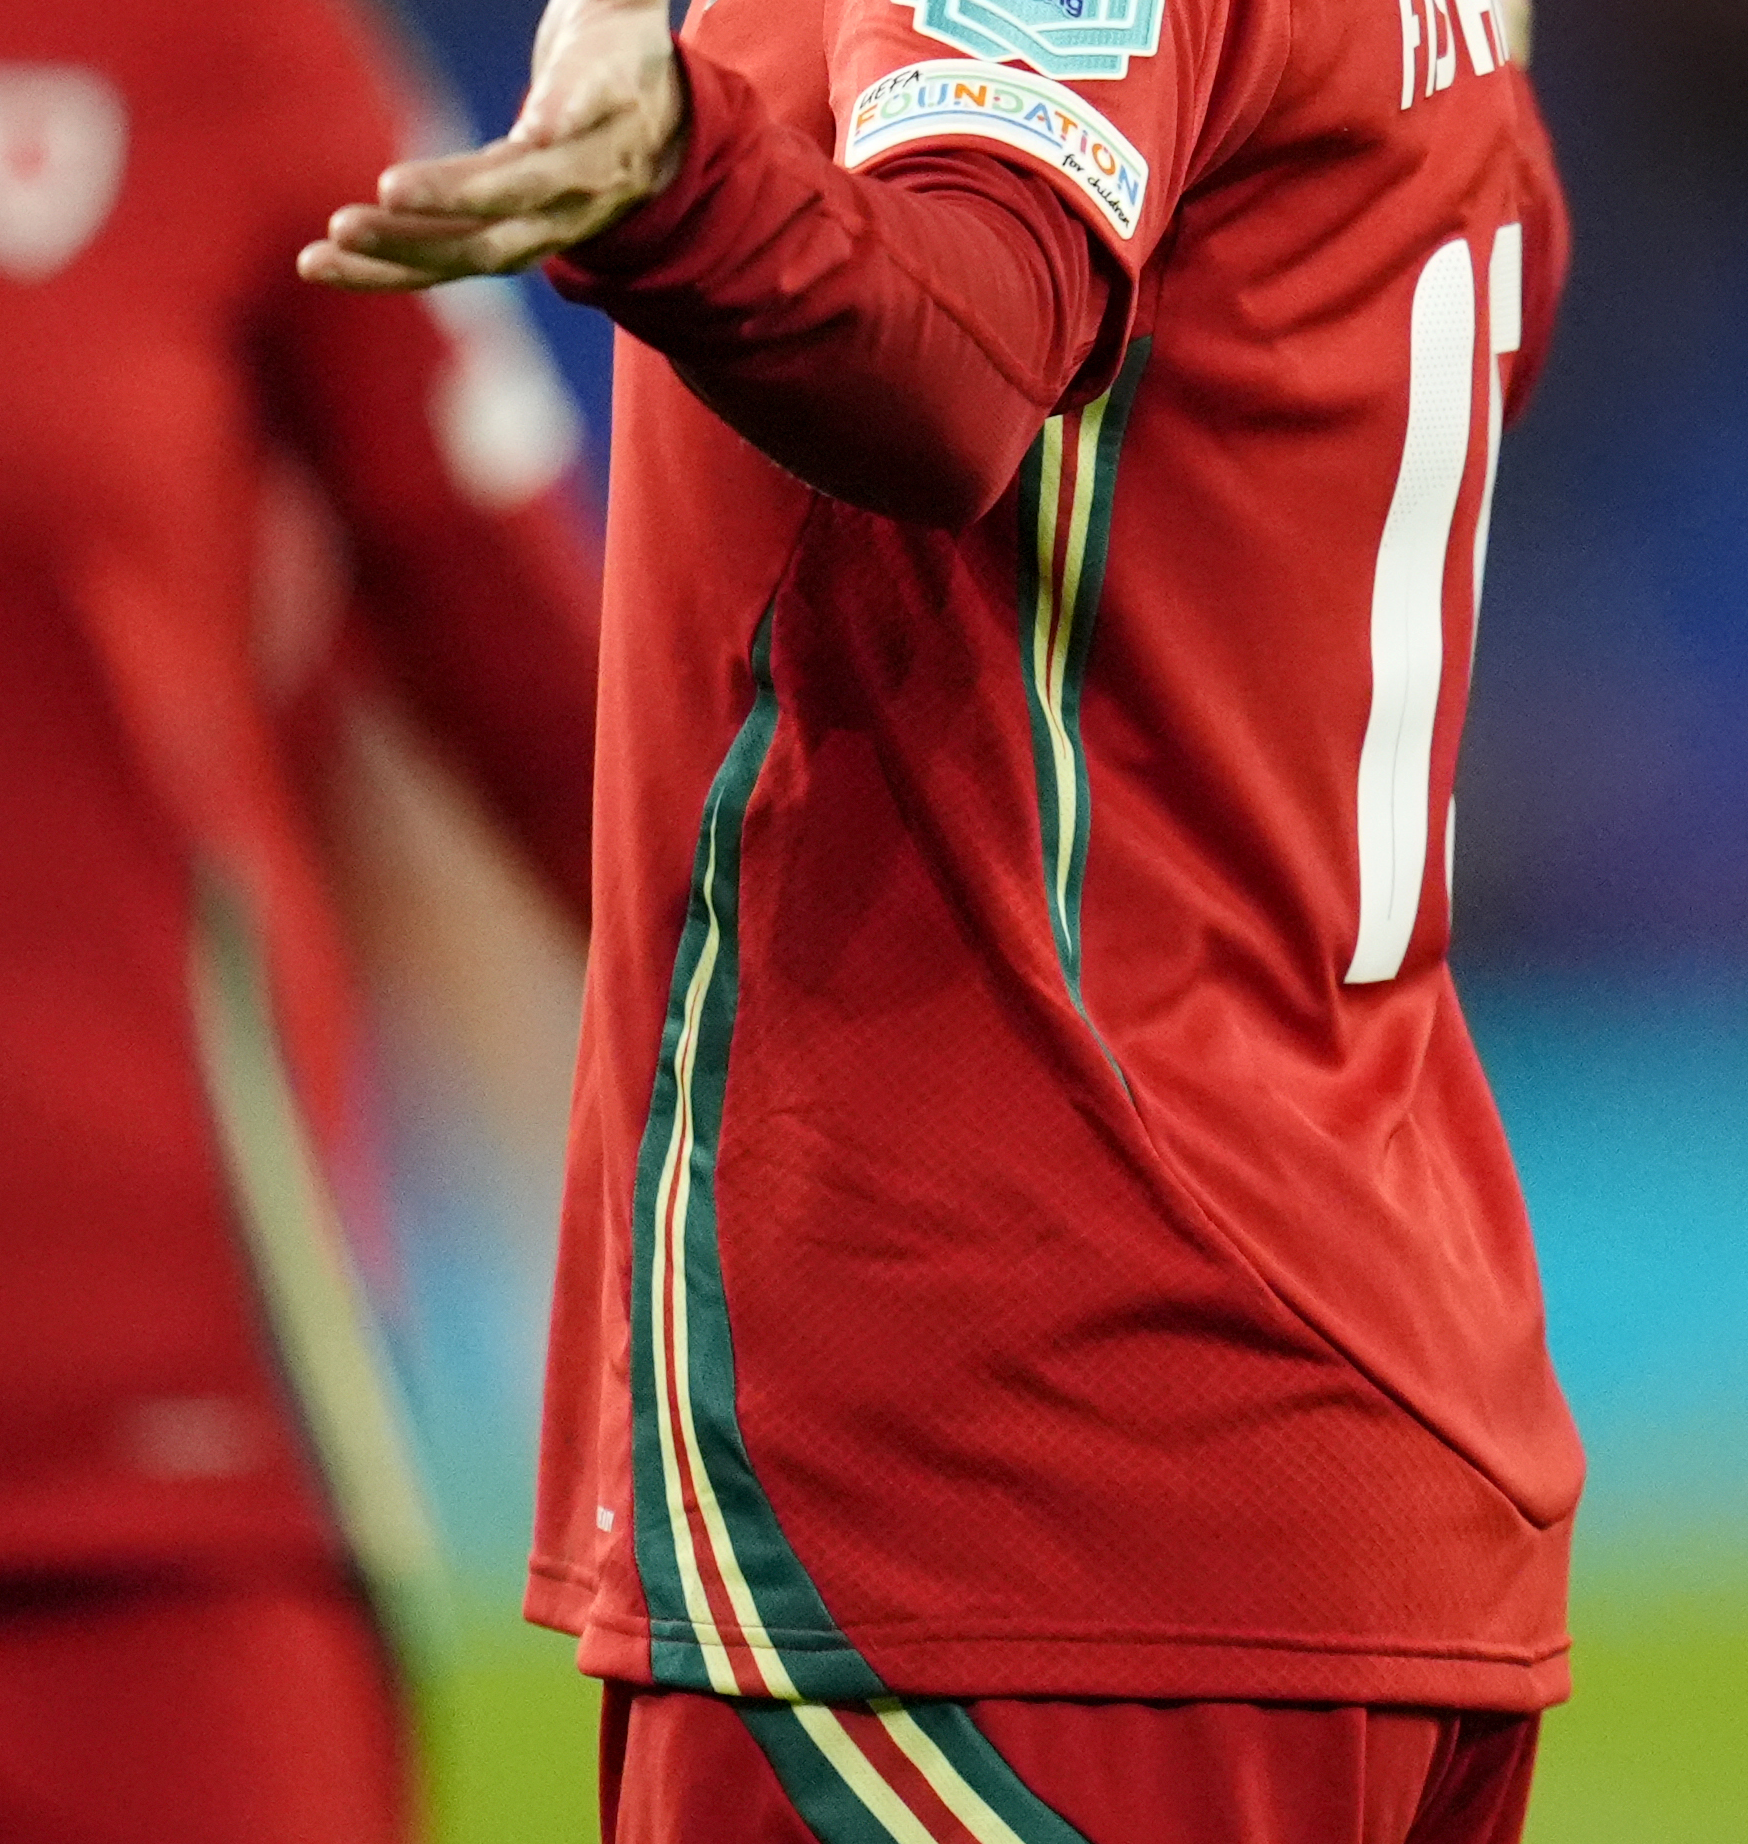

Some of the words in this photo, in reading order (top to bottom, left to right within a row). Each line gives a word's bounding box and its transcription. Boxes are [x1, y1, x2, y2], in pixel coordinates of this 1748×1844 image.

[859, 69, 923, 110] UEFA
[854, 82, 1140, 209] FOUNDATION
[1061, 153, 1086, 173] for
[1087, 176, 1131, 229] children
